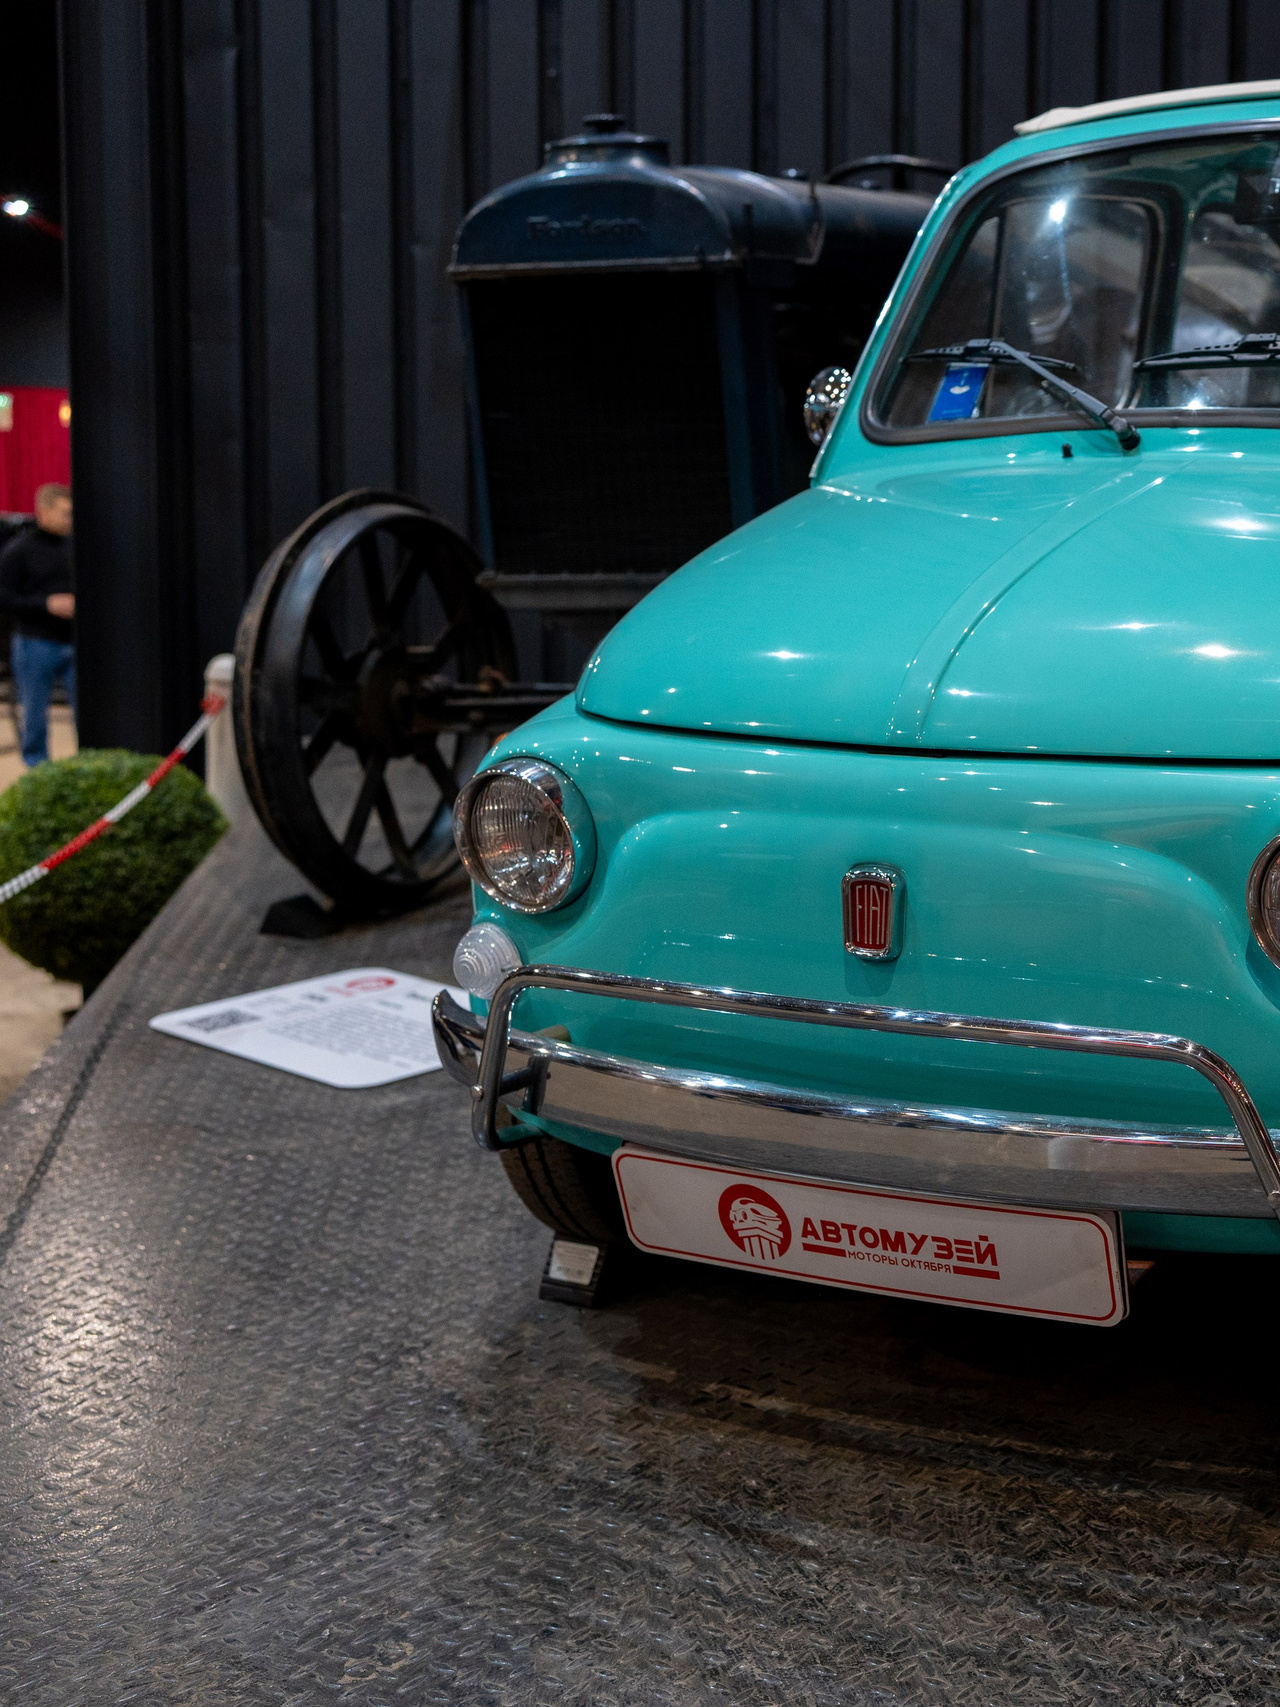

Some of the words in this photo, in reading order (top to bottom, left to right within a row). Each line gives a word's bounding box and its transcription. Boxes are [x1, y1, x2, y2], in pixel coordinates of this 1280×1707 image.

[855, 884, 889, 945] FIAT
[801, 1217, 998, 1266] АВТОМУЗЕЙ
[847, 1250, 899, 1266] МОТОРЫ
[901, 1258, 952, 1274] ОКТЯБРЯ
